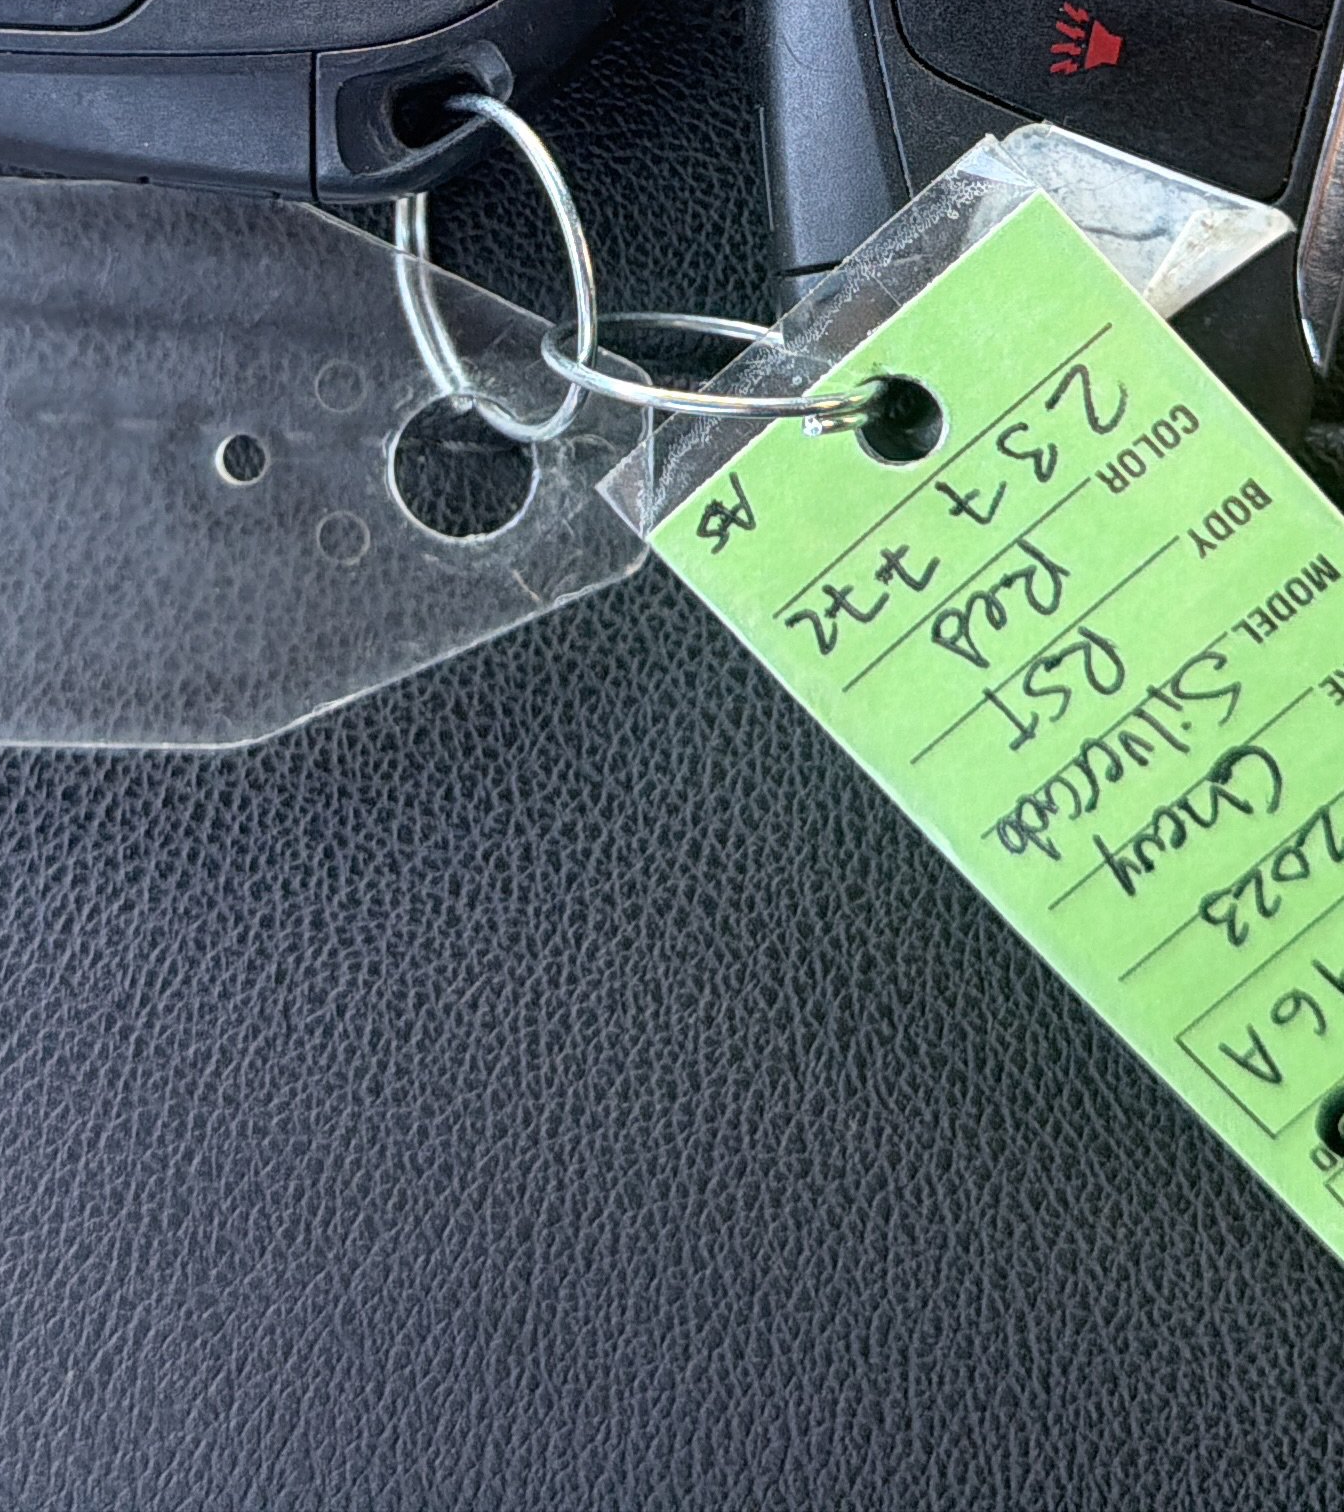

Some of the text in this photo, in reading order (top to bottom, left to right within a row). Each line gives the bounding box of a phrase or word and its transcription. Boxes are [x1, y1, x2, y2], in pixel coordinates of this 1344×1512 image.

[1094, 403, 1200, 495] COLOR
[1186, 477, 1274, 560] BODY
[1230, 553, 1342, 646] MODEL
[983, 625, 1126, 752] RST
[996, 650, 1242, 861] Silverado
[1092, 744, 1282, 897] Chevy
